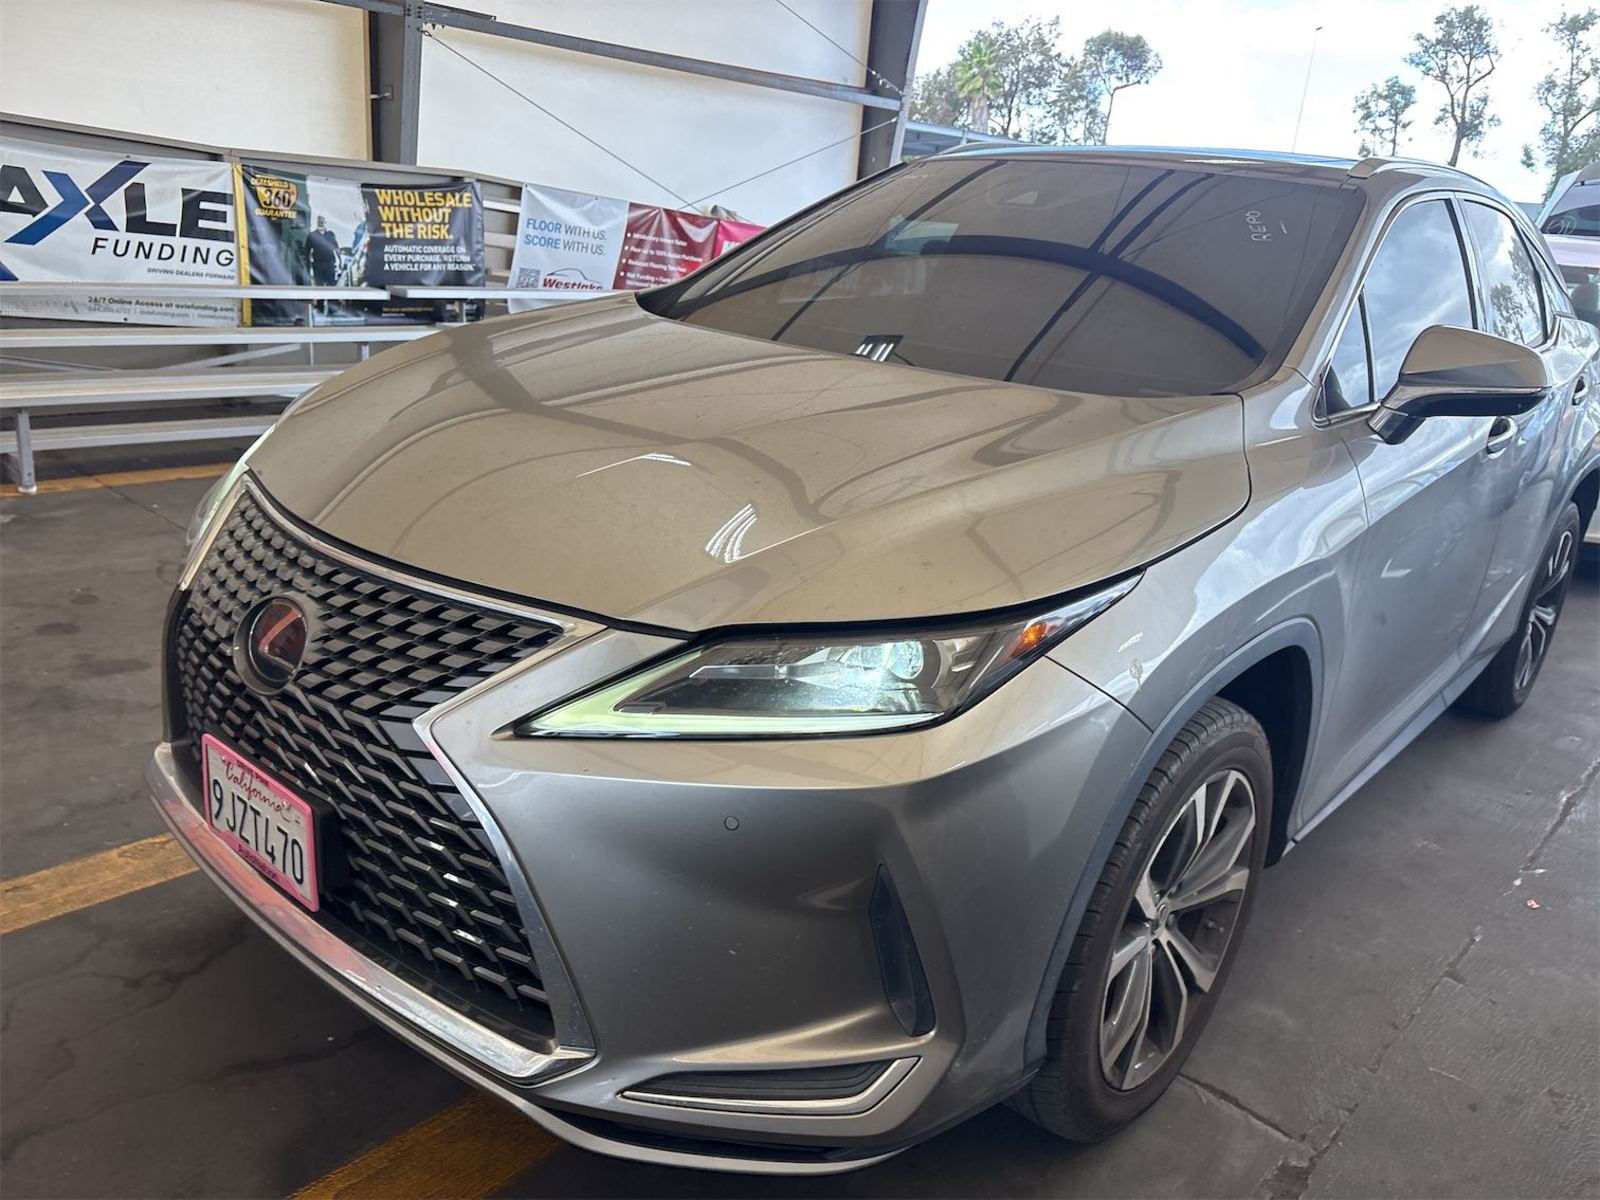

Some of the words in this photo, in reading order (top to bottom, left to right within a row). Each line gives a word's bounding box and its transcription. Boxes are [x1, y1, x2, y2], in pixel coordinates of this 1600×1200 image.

[0, 160, 235, 246] AXLE
[263, 188, 291, 207] 360
[374, 189, 472, 208] WHOLESALE
[254, 208, 297, 219] GUARANTEE
[378, 206, 451, 223] WITHOUT
[381, 222, 414, 238] THE
[417, 223, 453, 240] RISK.
[526, 218, 562, 233] FLOOR
[564, 224, 591, 238] WITH
[592, 229, 607, 241] US.
[91, 237, 235, 267] FUNDING
[384, 245, 422, 253] AUTOMATIC
[423, 245, 455, 253] COVERAGE
[524, 234, 560, 249] SCORE
[562, 240, 589, 254] WITH
[590, 244, 606, 256] US.
[383, 263, 390, 271] A
[390, 263, 419, 271] VEHICLE
[384, 254, 406, 262] EVERY
[147, 267, 174, 275] DRIVING
[175, 270, 203, 278] DEALERS
[88, 296, 106, 304] 24/7
[108, 298, 133, 306] Online
[135, 300, 163, 308] Access
[175, 303, 235, 312] axlefunding.com
[225, 761, 285, 812] California
[213, 778, 304, 885] 9JZT470
